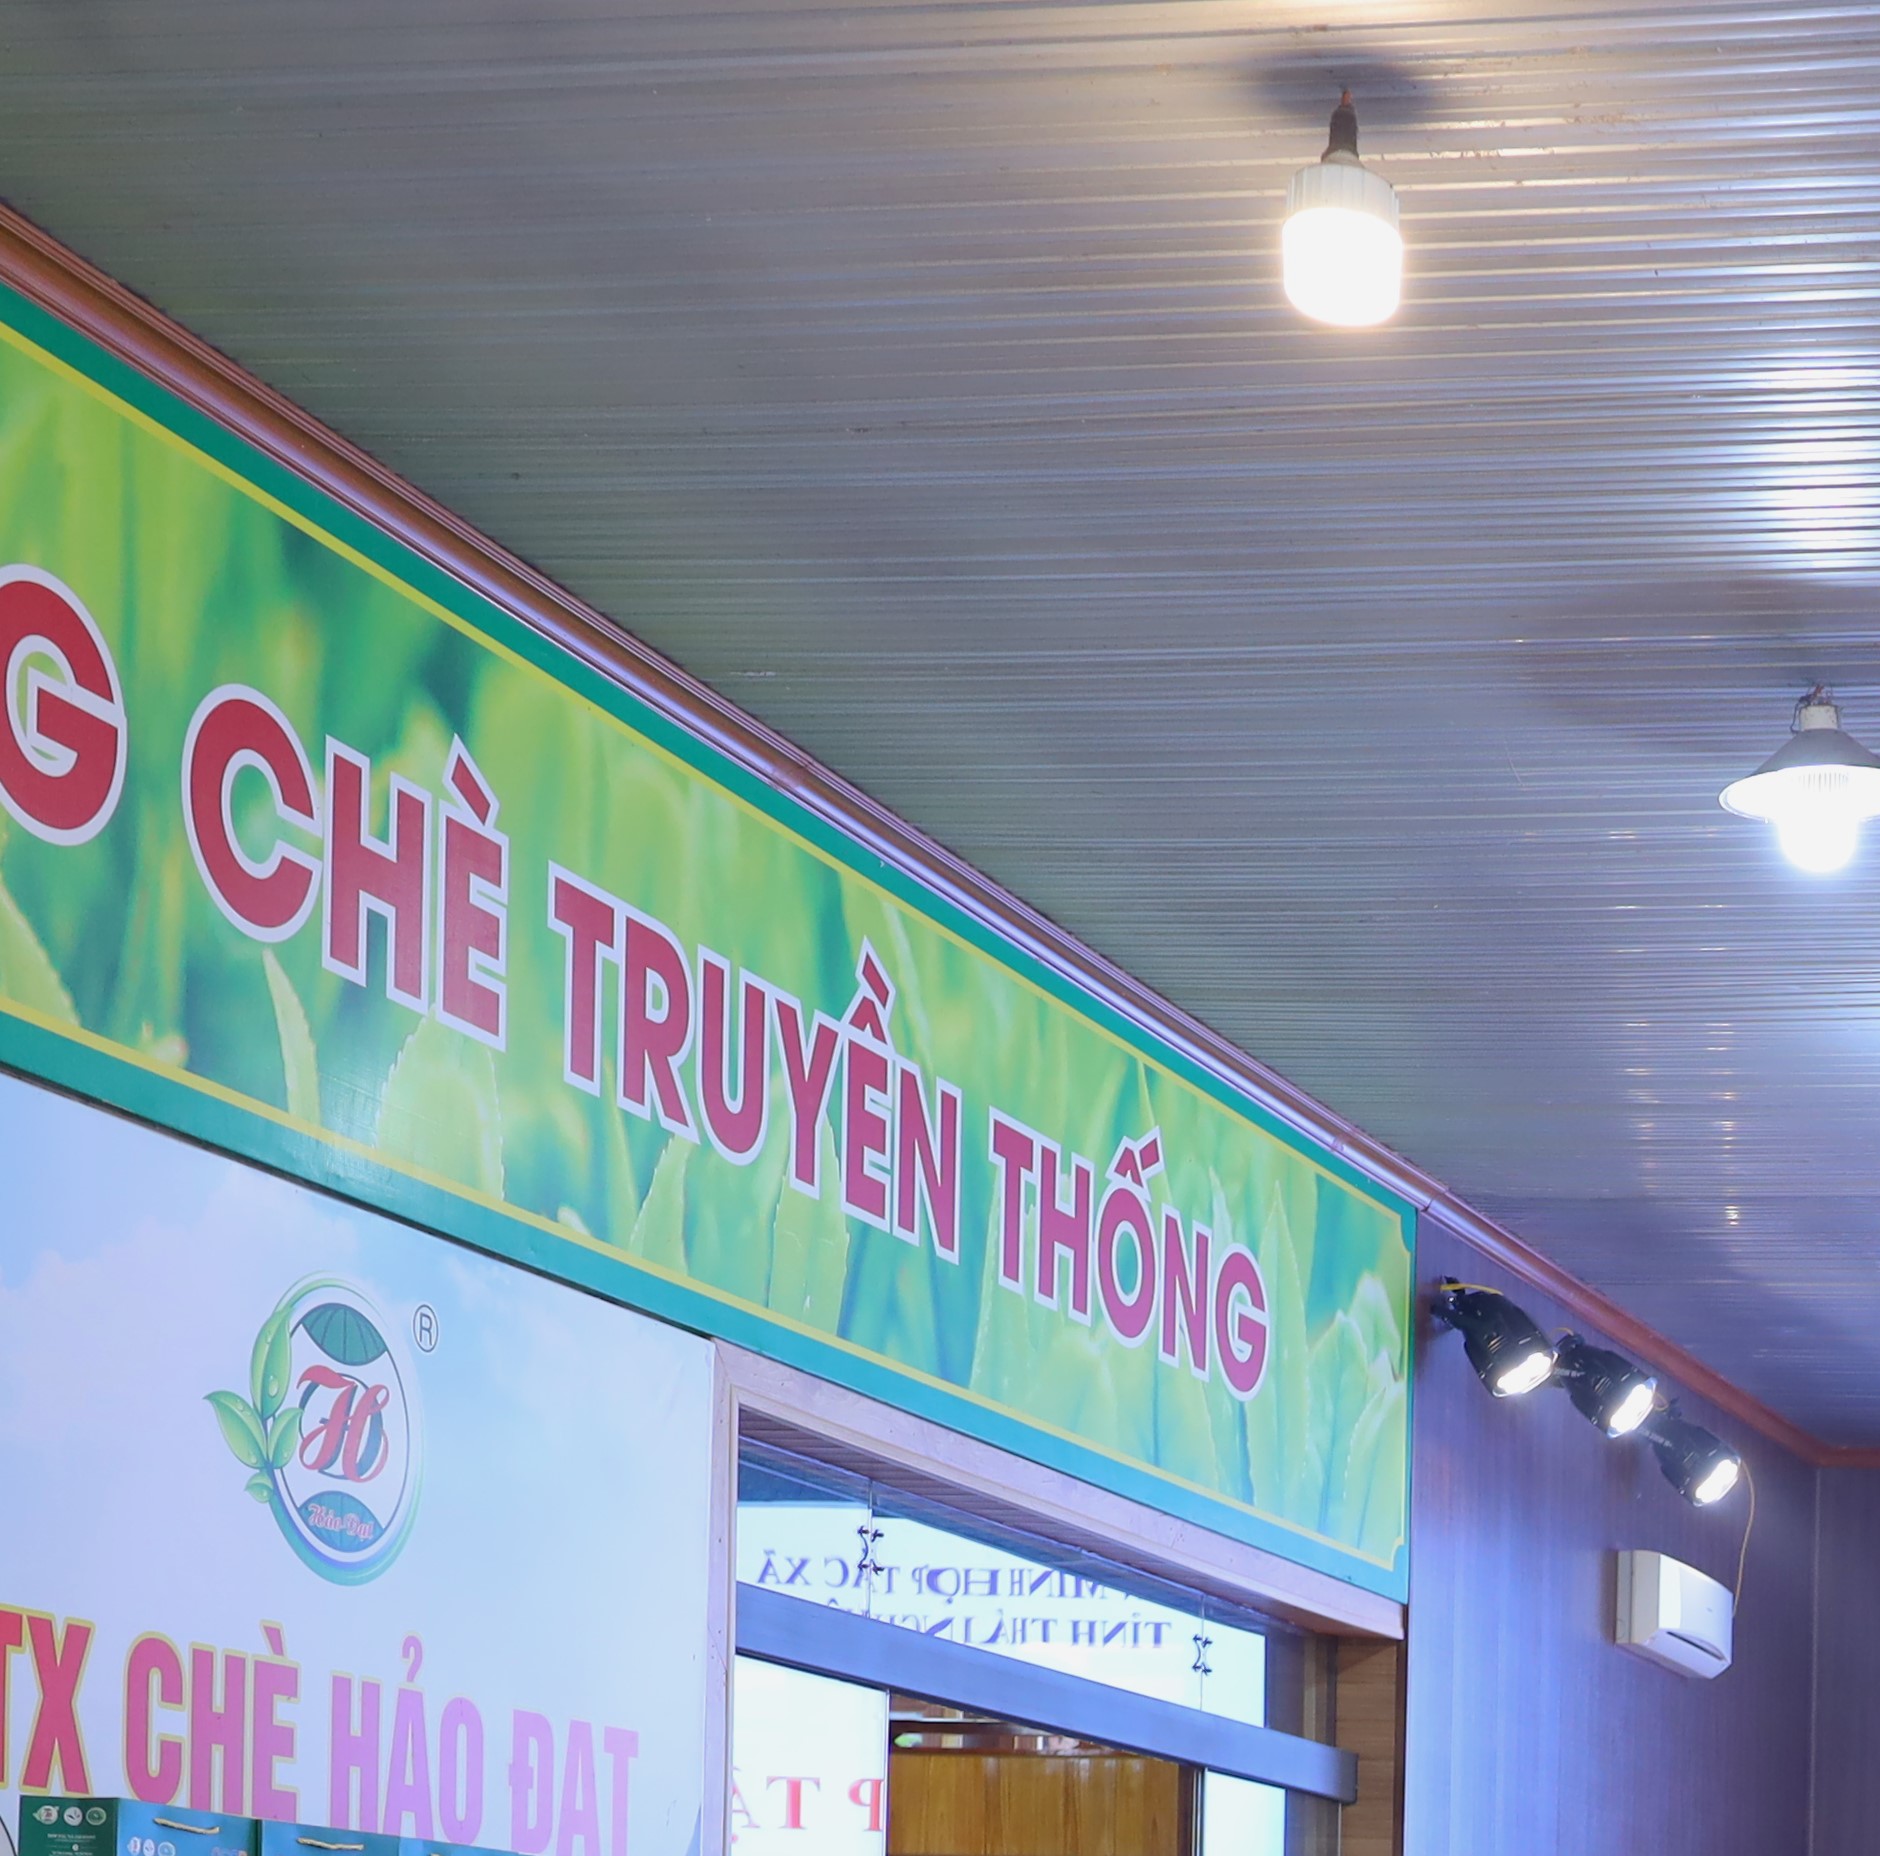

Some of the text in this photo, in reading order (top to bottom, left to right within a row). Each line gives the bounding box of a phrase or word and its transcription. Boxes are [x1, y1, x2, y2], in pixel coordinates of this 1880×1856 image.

[183, 683, 509, 1051] CHÈ
[548, 861, 961, 1264] TRUYỀN
[990, 1104, 1269, 1400] THỐNG
[123, 1619, 300, 1822] CHÈ
[328, 1633, 485, 1846] HẢO
